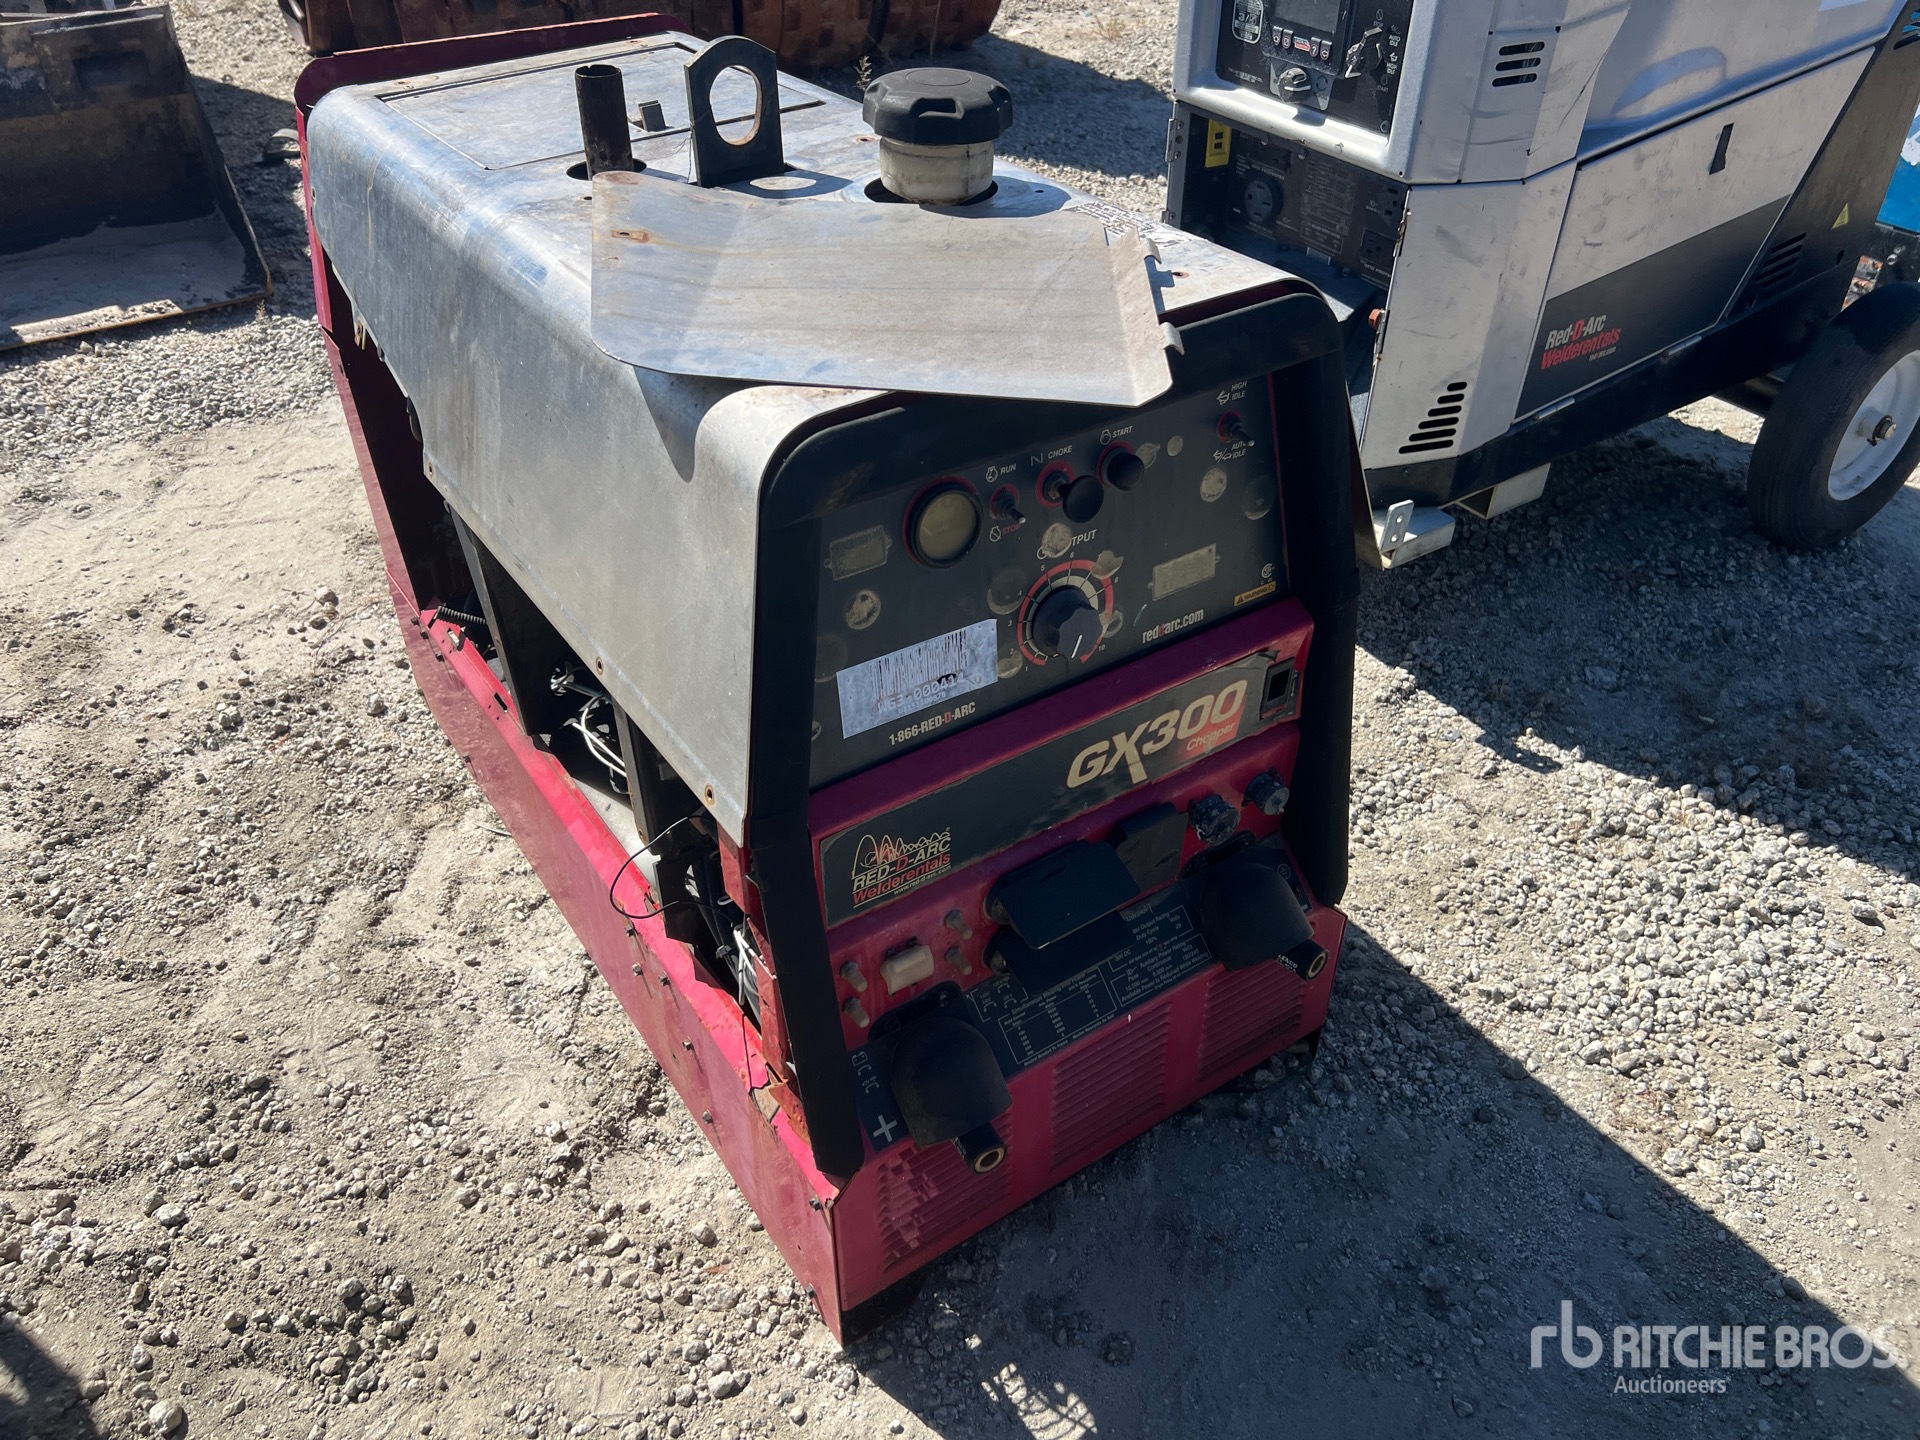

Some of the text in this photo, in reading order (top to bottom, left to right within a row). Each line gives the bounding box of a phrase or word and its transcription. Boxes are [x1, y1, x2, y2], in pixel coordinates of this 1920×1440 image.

[1388, 34, 1400, 42] AUTO
[1544, 315, 1606, 350] Red-D-Arc
[1541, 328, 1621, 370] Welderentals
[1231, 381, 1248, 391] HIGH
[1232, 390, 1246, 400] IDLE
[1112, 426, 1133, 438] START
[1048, 445, 1073, 459] CHOKE
[1232, 449, 1246, 460] IDLE
[1000, 464, 1016, 475] RUN
[888, 702, 976, 746] 1-866-RED-D-ARC
[1066, 680, 1248, 788] GX300
[1186, 722, 1237, 752] Chopper
[853, 837, 951, 891] RED-D-ARC
[853, 853, 951, 905] Welderentals
[894, 865, 952, 895] www.red-d-arc.com
[1140, 919, 1155, 930] Output
[1156, 912, 1169, 922] Rating
[1136, 932, 1147, 940] Duty
[1147, 925, 1159, 935] Cycle
[1159, 949, 1172, 958] Power
[1172, 941, 1186, 951] Rating
